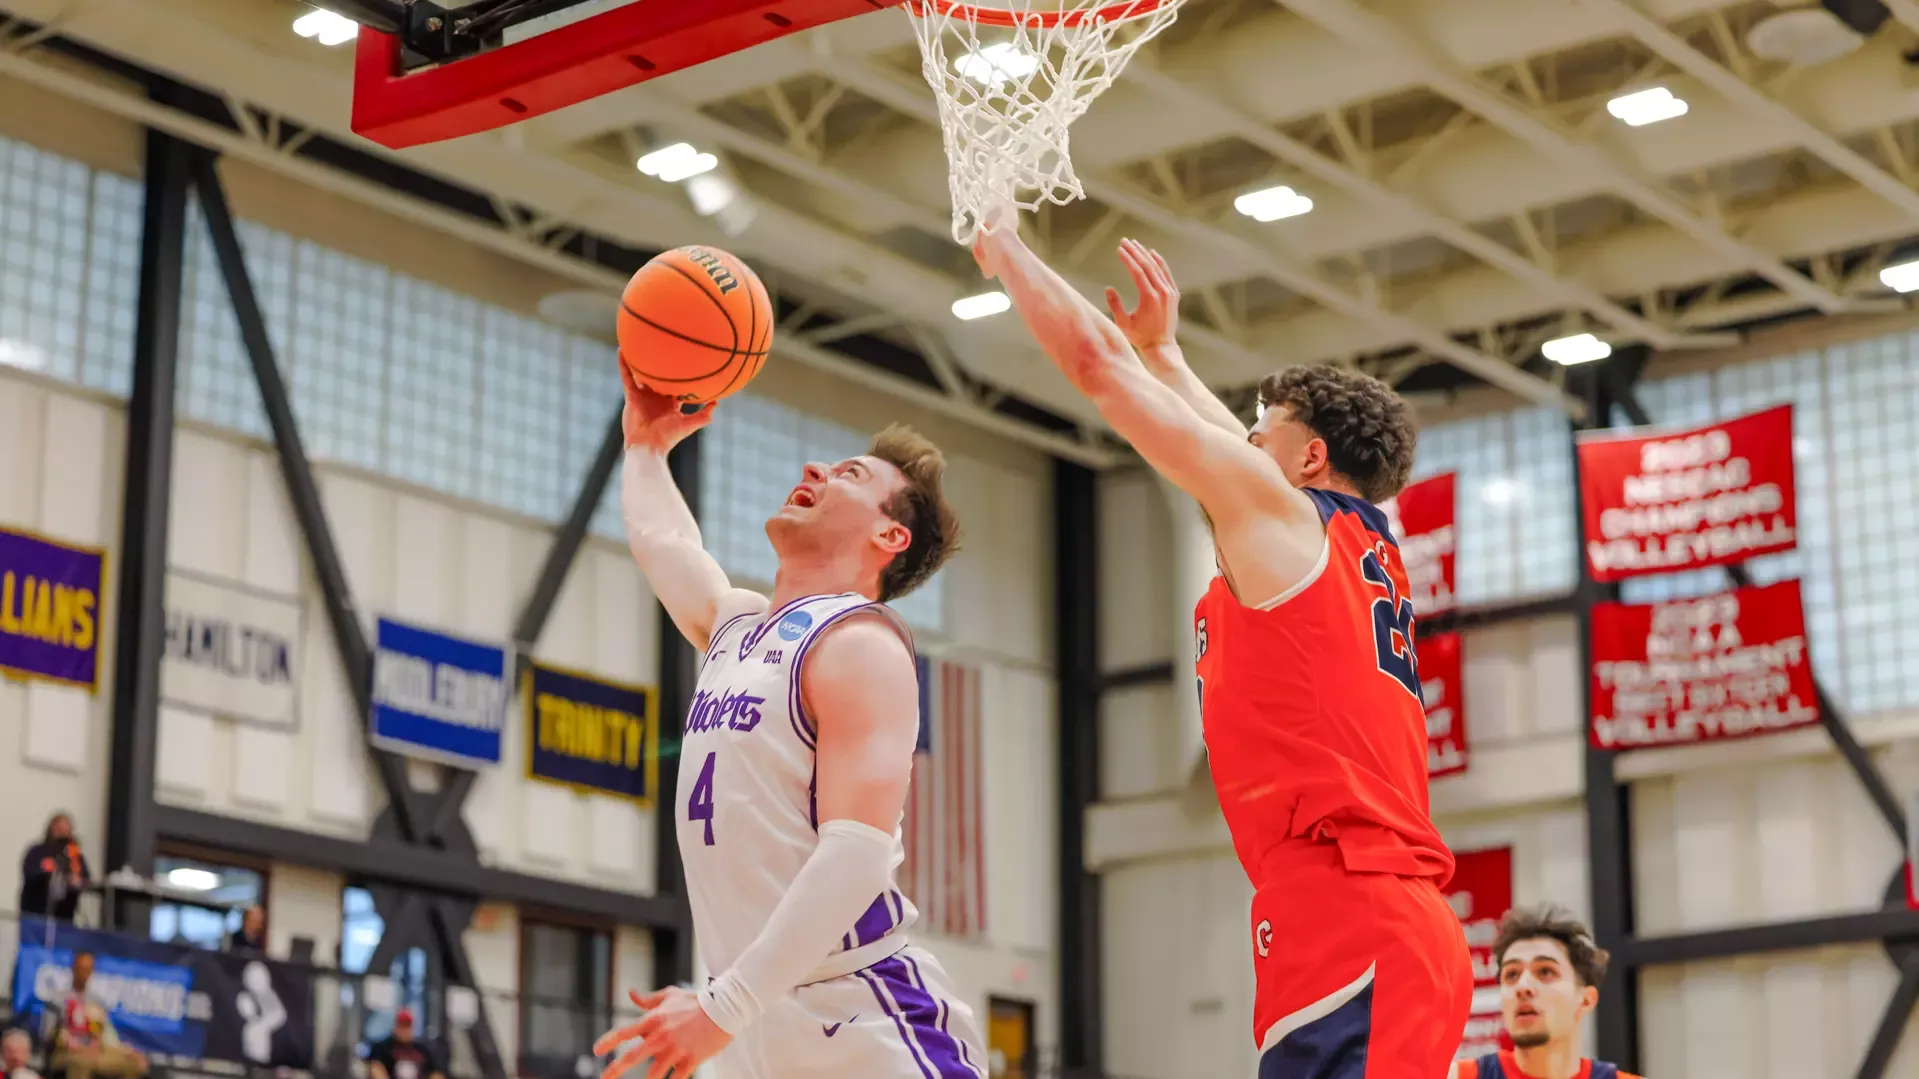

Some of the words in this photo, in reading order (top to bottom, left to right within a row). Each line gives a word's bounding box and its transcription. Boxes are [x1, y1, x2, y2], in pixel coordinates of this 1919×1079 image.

[1600, 482, 1783, 540] CHAMPIONS
[1587, 513, 1795, 571] VOLLEYBALL
[0, 569, 95, 650] LIAMS
[764, 650, 783, 664] UAA
[1594, 635, 1804, 691] TOURNAMENT
[537, 692, 643, 771] TRINITY
[684, 686, 766, 737] Violets
[1595, 695, 1817, 747] VOLLEYBALL
[688, 752, 715, 846] 4
